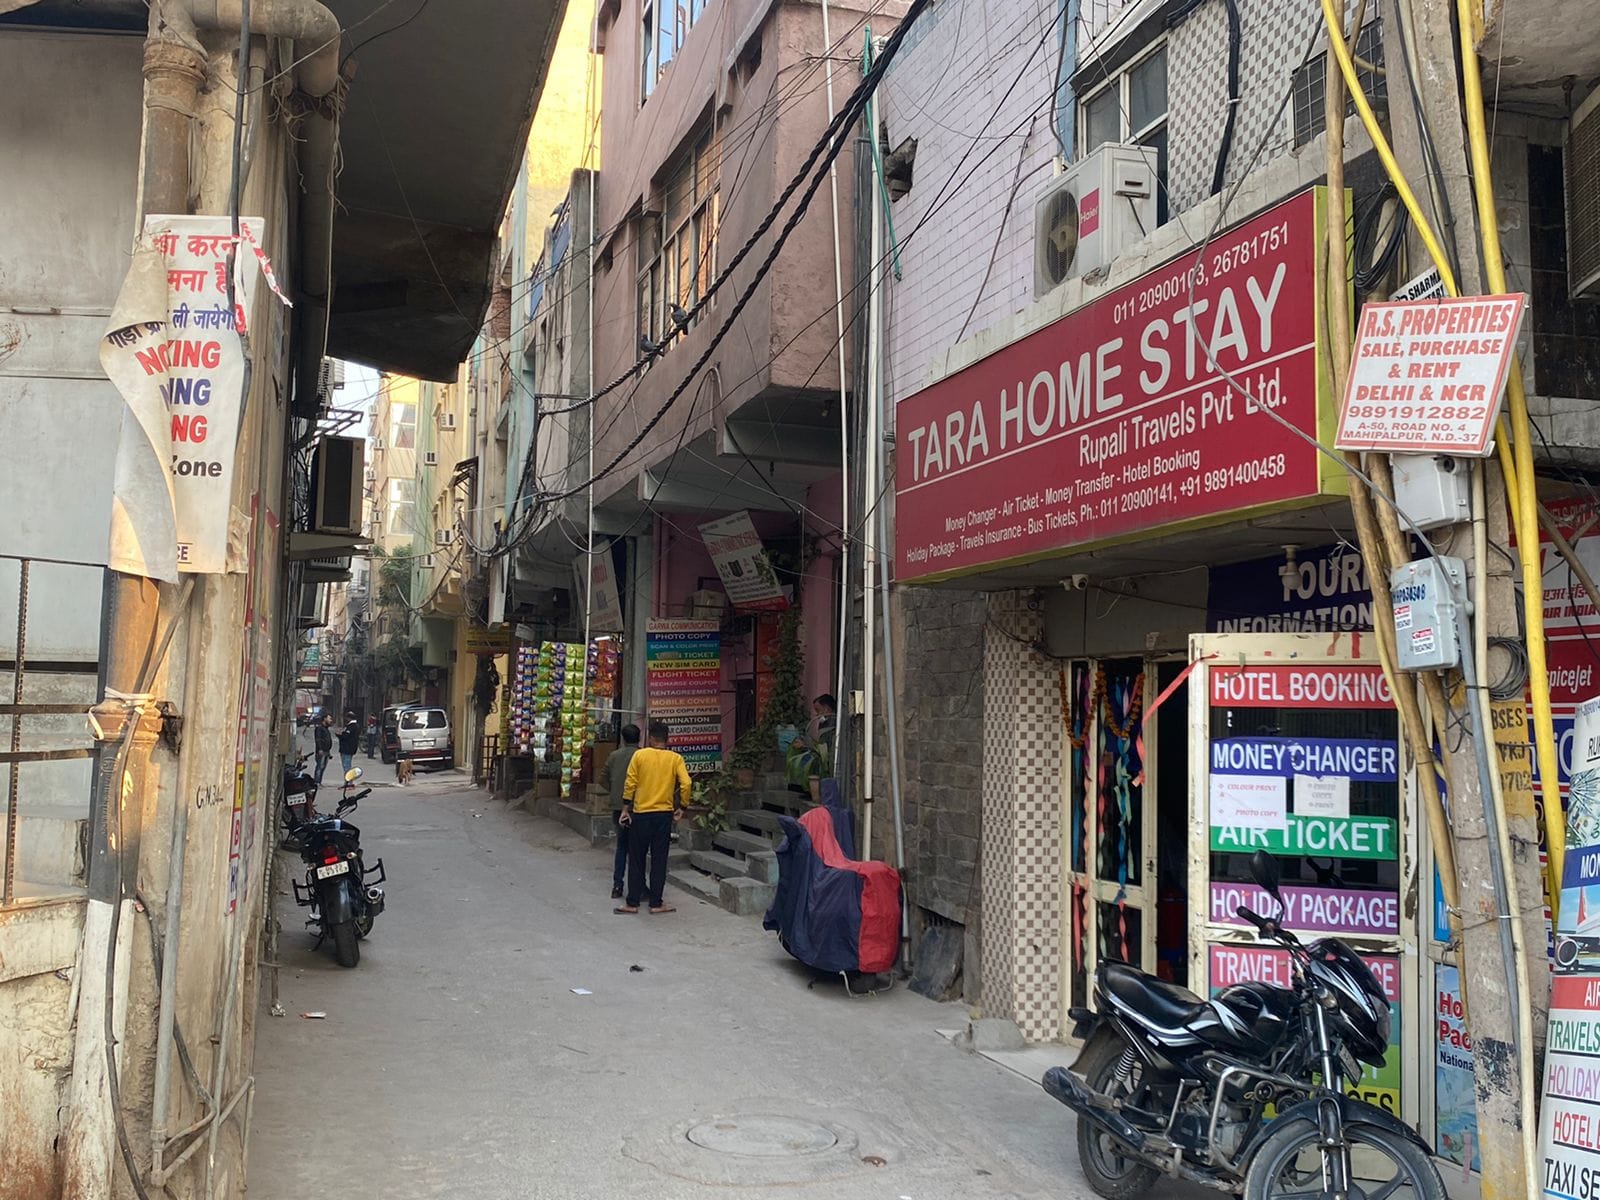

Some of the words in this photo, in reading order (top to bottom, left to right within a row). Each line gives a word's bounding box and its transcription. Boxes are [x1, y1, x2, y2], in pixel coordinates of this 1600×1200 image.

[1114, 297, 1135, 324] 011
[1213, 221, 1288, 278] 26781751
[1364, 311, 1396, 338] R.S.
[1400, 304, 1513, 336] PROPERTIES
[168, 339, 221, 369] ING
[1361, 342, 1404, 358] SALE,
[1408, 339, 1502, 356] PURCHASE
[908, 401, 989, 481] TARA
[1000, 337, 1123, 450] HOME
[1140, 262, 1287, 395] STAY
[1388, 363, 1401, 378] &
[1408, 362, 1460, 378] RENT
[1356, 385, 1415, 400] DELHI
[1420, 385, 1435, 401] &
[1441, 385, 1486, 401] NCR
[1080, 420, 1128, 469] Rupali
[1132, 400, 1196, 450] Travels
[1202, 384, 1234, 429] Pvt
[1246, 367, 1287, 415] Ltd.
[1348, 406, 1486, 420] 9891912882
[1358, 422, 1388, 432] A-50,
[1392, 422, 1425, 432] ROAD
[1431, 423, 1454, 432] NO.
[1458, 424, 1467, 432] 4
[1343, 430, 1427, 441] MAHIPALPUR,
[945, 517, 967, 532] Money
[967, 507, 998, 526] Changer
[1002, 500, 1014, 517] Air
[1015, 492, 1040, 514] Ticket
[1045, 485, 1073, 506] Money
[1075, 471, 1115, 497] Transfer
[1123, 459, 1151, 484] Hotel
[1153, 449, 1201, 477] Booking
[907, 547, 929, 563] Holiday
[929, 540, 956, 559] Package
[960, 533, 985, 551] Travels
[985, 523, 1022, 544] Insurance
[1028, 518, 1044, 535] Bus
[1045, 509, 1079, 531] Tickets,
[1101, 495, 1118, 517] 011
[1121, 482, 1178, 512] 20900141,
[1180, 475, 1201, 497] +91
[1204, 453, 1286, 493] 9891400458
[1215, 671, 1284, 701] HOTEL
[1290, 671, 1394, 702] BOOKING
[1547, 664, 1592, 694] piceJet
[655, 716, 710, 724] AMINATION
[1490, 708, 1523, 731] BSES
[671, 744, 718, 752] RECHARGE
[683, 753, 711, 761] ONERY
[1213, 743, 1286, 771] MONEY
[1291, 744, 1396, 774] CHANGER
[1218, 825, 1269, 847] AIR
[1284, 820, 1390, 853] TICKET
[1211, 888, 1297, 922] HOLIDAY
[1301, 893, 1398, 929] PACKAGE
[1215, 951, 1284, 988] TRAVEL
[1439, 1020, 1473, 1051] Pac
[1439, 1050, 1475, 1072] Nationa
[1553, 1110, 1593, 1148] HOTEL
[1545, 1158, 1576, 1196] TAXI
